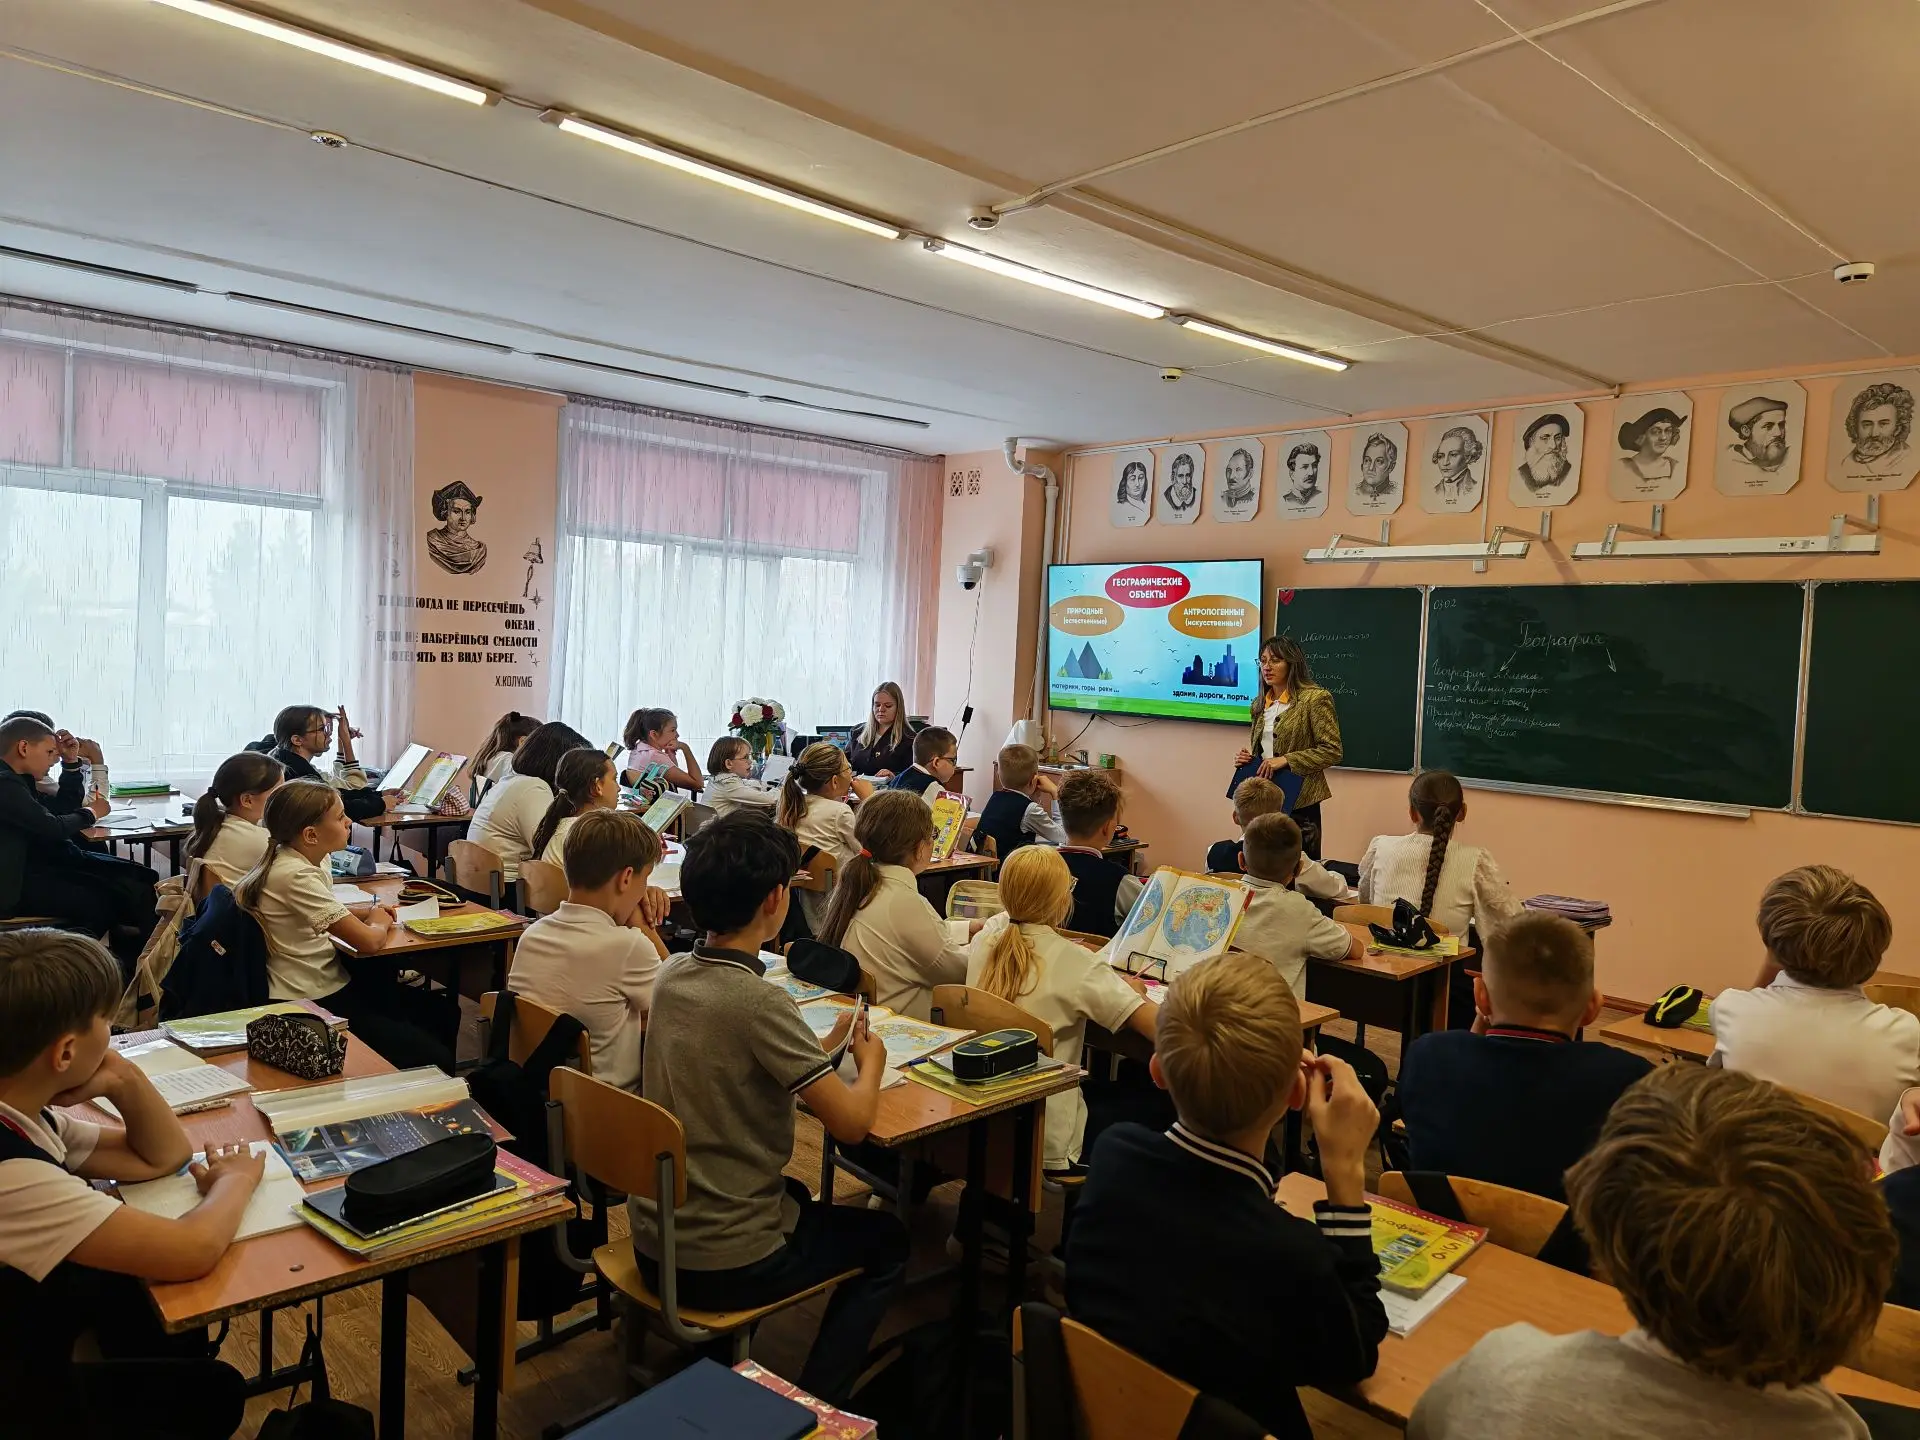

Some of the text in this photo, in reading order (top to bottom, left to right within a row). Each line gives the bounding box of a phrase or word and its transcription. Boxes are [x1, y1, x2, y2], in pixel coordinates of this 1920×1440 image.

[1112, 577, 1183, 588] ГЕОГРАФИЧЕСКИЕ
[1128, 590, 1167, 600] ОБЪЕКТЫ
[446, 599, 459, 611] НЕ
[462, 600, 526, 615] ПЕРЕСЕЧЁШЬ
[1066, 607, 1104, 616] ПРИРОДНЫЕ
[1183, 607, 1245, 617] АНТРОПОГЕННЫЕ
[1063, 617, 1108, 626] (естественные)
[1185, 618, 1243, 628] (искусственные)
[421, 631, 489, 646] НАБЕРЁШЬСЯ
[493, 635, 538, 648] СМЕЛОСТИ
[440, 651, 453, 663] ИЗ
[457, 652, 483, 664] ВИДУ
[486, 652, 517, 664] БЕРЕГ.
[495, 675, 533, 688] Х.КОЛУМБ
[1172, 690, 1249, 702] здания, дороги, порты
